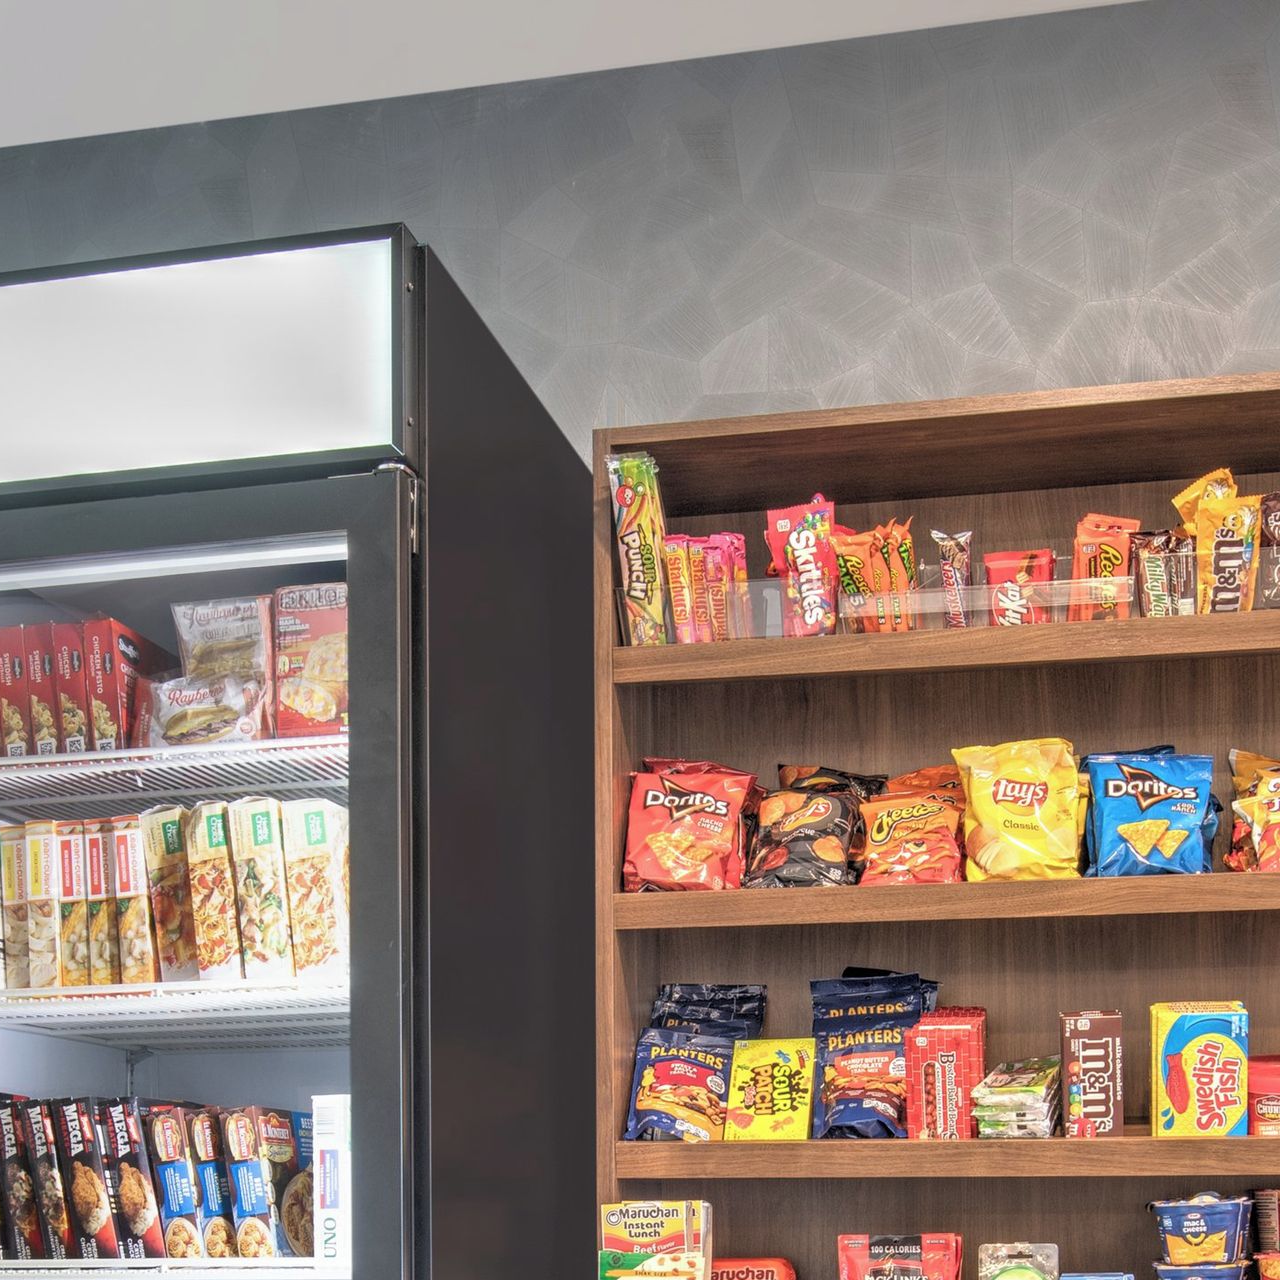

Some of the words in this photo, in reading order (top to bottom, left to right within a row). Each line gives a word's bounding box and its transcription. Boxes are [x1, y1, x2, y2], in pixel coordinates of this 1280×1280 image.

[621, 530, 647, 600] PUNCH
[639, 544, 657, 583] SOUR
[788, 530, 825, 626] Skittles
[668, 555, 690, 624] Starburst
[849, 594, 866, 609] 5
[2, 652, 13, 687] SWEDISH
[32, 649, 42, 684] SWEDISH
[61, 645, 72, 680] CHICKEN
[91, 635, 101, 670] CHICKEN
[96, 670, 104, 695] PESTO
[645, 789, 729, 815] Doritos
[995, 778, 1047, 807] Lay's
[1106, 778, 1199, 800] Doritos
[164, 823, 175, 852] Choice
[209, 816, 218, 846] Choice
[254, 814, 264, 844] Choice
[869, 803, 946, 846] Cheetos
[1003, 818, 1040, 832] Classic
[827, 1027, 902, 1052] PLANTERS
[650, 1046, 725, 1071] PLANTERS
[939, 1052, 956, 1087] Boston
[753, 1063, 774, 1116] PATCH
[772, 1064, 793, 1113] SOUR
[1115, 1058, 1123, 1101] chocolate
[1195, 1040, 1225, 1133] Swedish
[1213, 1056, 1243, 1112] Fish
[947, 1087, 958, 1112] Baked
[27, 1106, 48, 1159] MEGA
[62, 1103, 84, 1157] MEGA
[108, 1105, 131, 1158] MEGA
[180, 1177, 191, 1198] BEEF
[253, 1177, 263, 1197] BEEF
[618, 1206, 680, 1219] Maruchan
[623, 1220, 665, 1230] Instant
[322, 1216, 338, 1260] UNO
[628, 1229, 661, 1239] Lunch
[632, 1243, 658, 1254] Beef
[870, 1245, 884, 1254] 100
[884, 1245, 922, 1254] CALORIES
